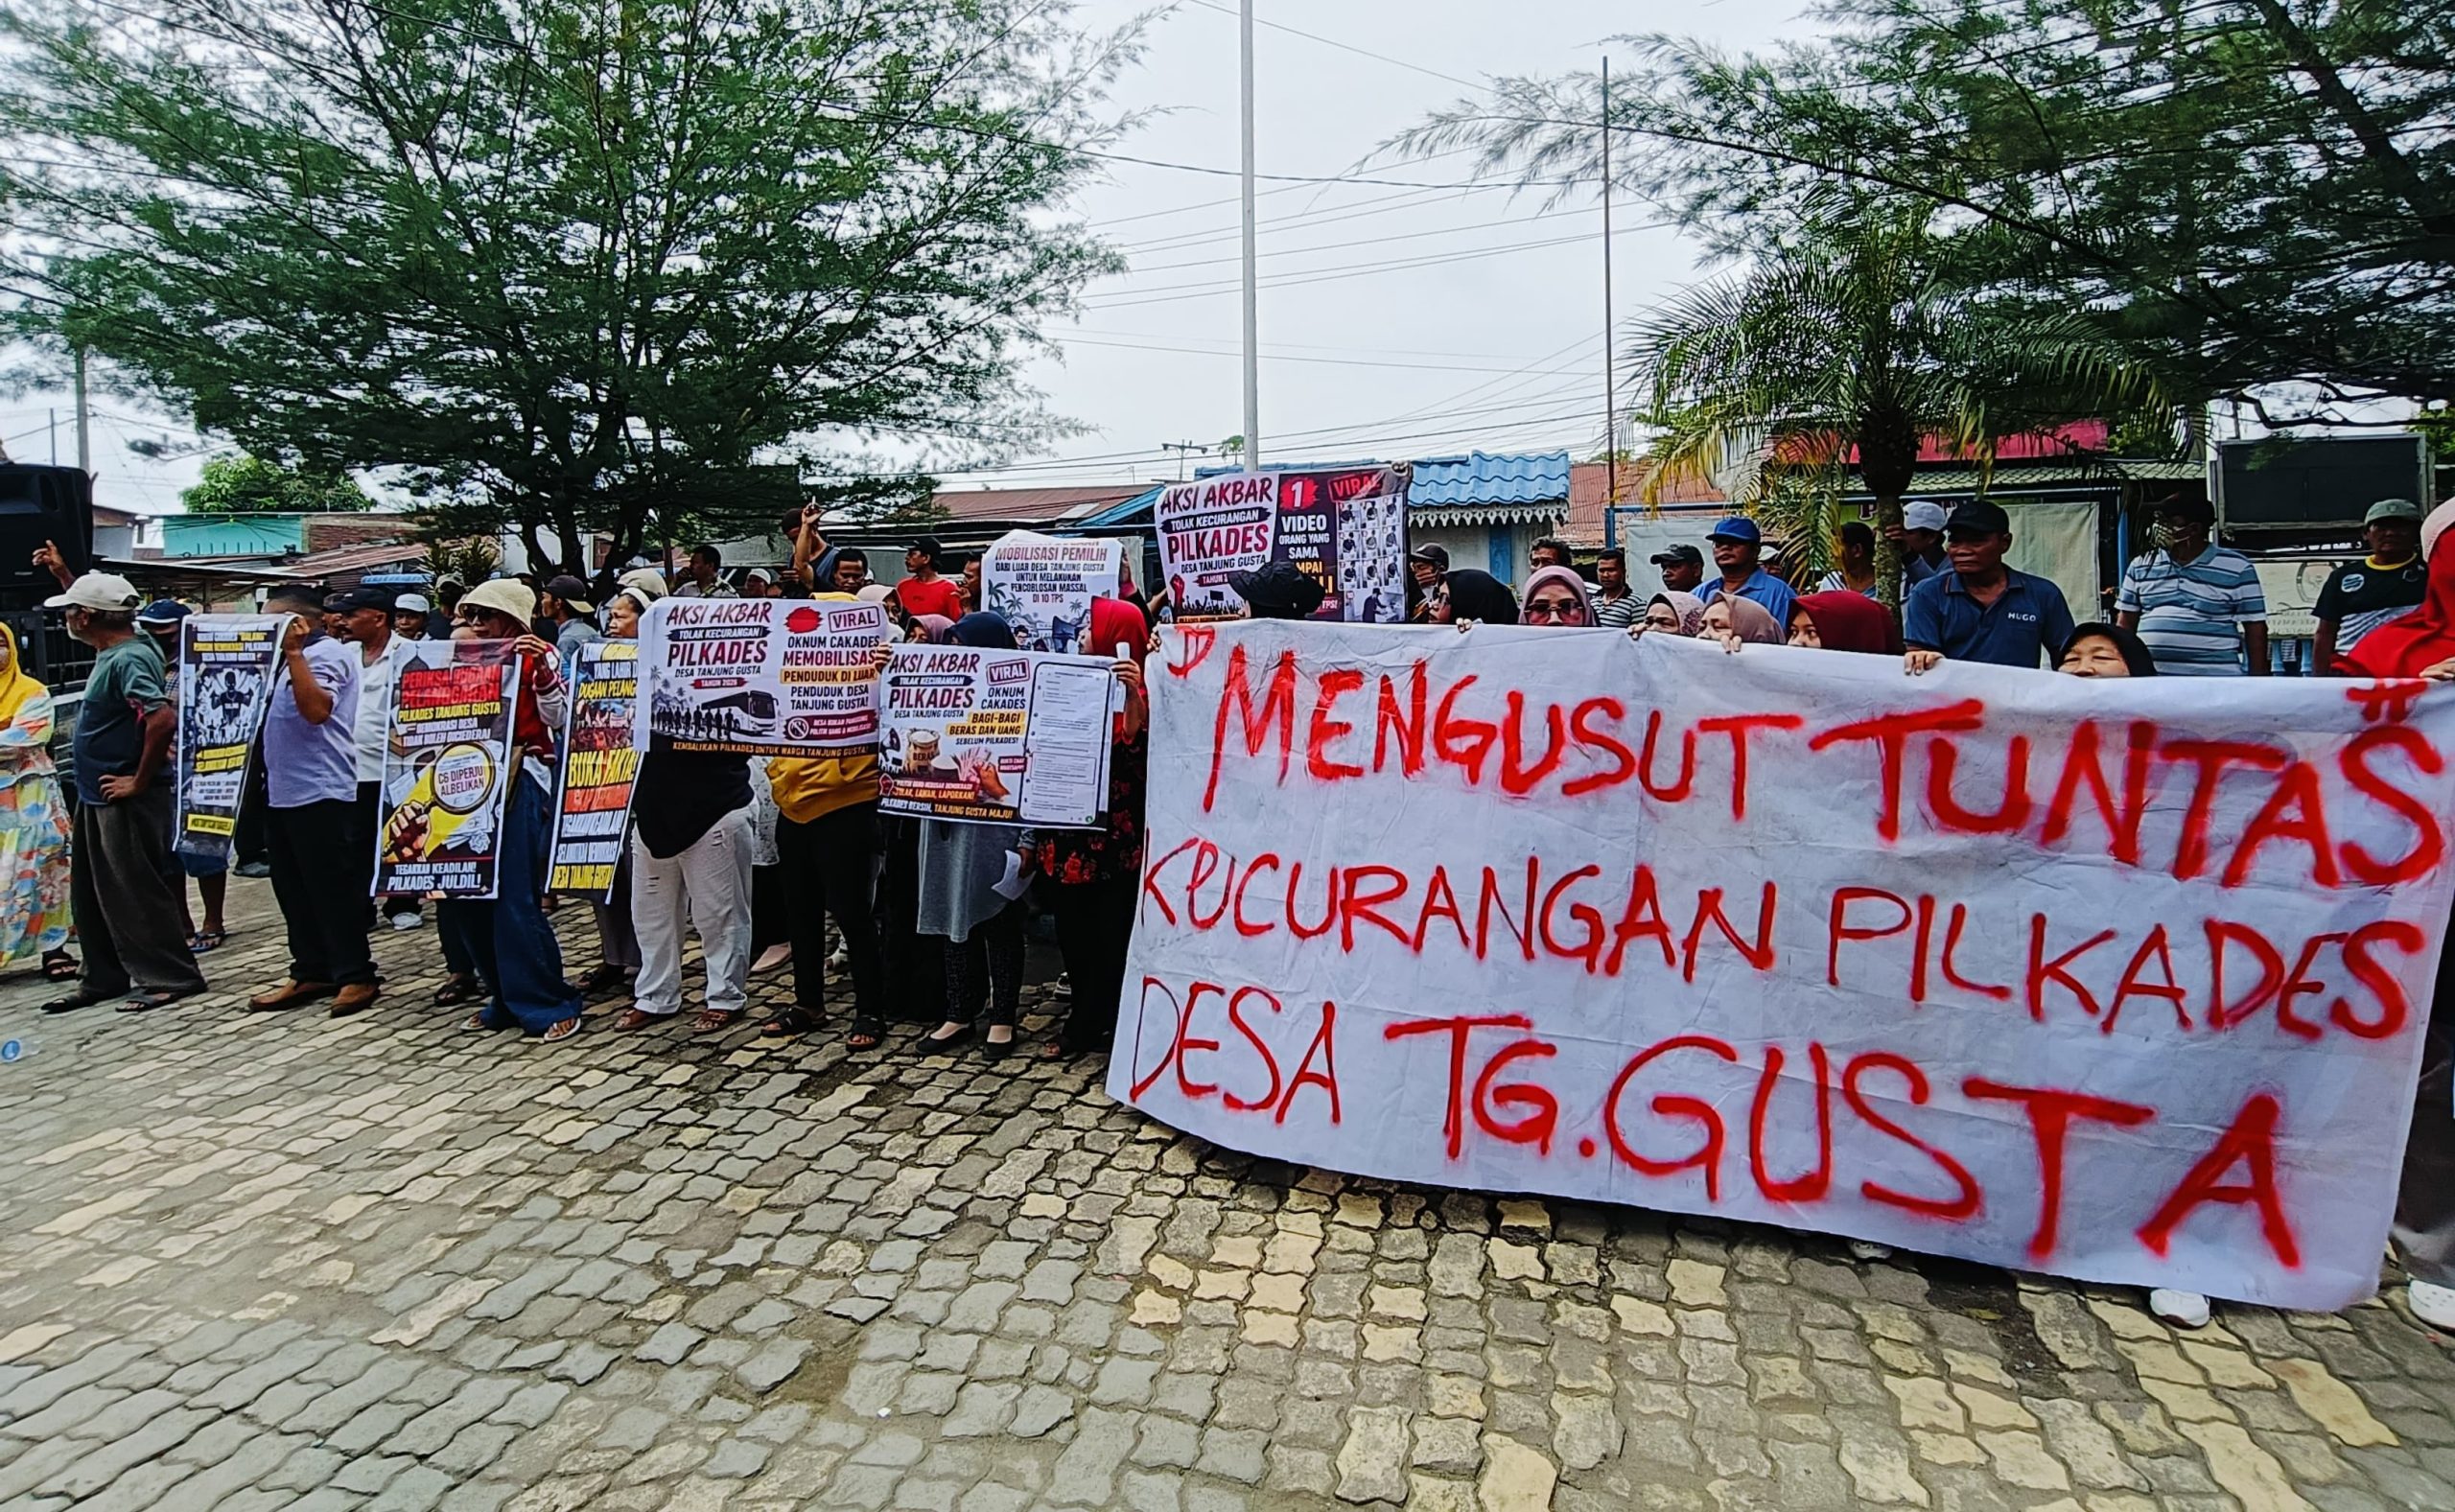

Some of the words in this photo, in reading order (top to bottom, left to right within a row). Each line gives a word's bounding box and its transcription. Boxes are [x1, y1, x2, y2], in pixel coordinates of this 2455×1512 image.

[1160, 485, 1197, 515] AKSI
[1204, 477, 1274, 508] AKBAR
[1291, 481, 1303, 507] 1
[1171, 518, 1195, 531] TOLAK
[1197, 509, 1259, 528] KECURANGAN
[1281, 515, 1327, 533] VIDEO
[1167, 524, 1269, 564] PILKADES
[1278, 534, 1307, 546] ORANG
[1308, 533, 1330, 544] YANG
[995, 547, 1058, 562] MOBILISASI
[1062, 547, 1108, 562] PEMILIH
[1288, 547, 1319, 559] SAMA
[995, 563, 1011, 572] DARI
[1012, 563, 1029, 572] LUAR
[1031, 563, 1048, 572] DESA
[1050, 563, 1081, 572] TANJUNG
[1082, 563, 1105, 572] GUSTA
[1181, 561, 1198, 574] DESA
[1199, 558, 1235, 571] TANJUNG
[1237, 554, 1267, 567] GUSTA
[1296, 561, 1322, 574] MPAI
[1016, 572, 1038, 582] UNTUK
[1039, 572, 1082, 582] MELAKUKAN
[1011, 583, 1057, 593] PENCOBLOSAN
[1059, 583, 1087, 593] MASSAL
[1032, 593, 1040, 603] DI
[1041, 593, 1049, 603] 10
[1051, 593, 1064, 603] TPS
[666, 604, 709, 626] AKSI
[710, 601, 772, 624] AKBAR
[832, 611, 876, 629] VIRAL
[2007, 612, 2037, 622] HUGO
[679, 630, 704, 640] TOLAK
[787, 636, 827, 648] OKNUM
[830, 635, 880, 648] CAKADES
[667, 640, 768, 667] PILKADES
[783, 649, 877, 666] MEMOBILISAS
[675, 668, 694, 678] DESA
[697, 667, 734, 677] TANJUNG
[736, 665, 761, 675] GUSTA
[888, 654, 924, 674] AKSI
[925, 653, 981, 673] AKBAR
[402, 669, 450, 689] PERIKSA
[783, 670, 838, 682] PENDUDUK
[841, 670, 851, 682] DI
[853, 668, 876, 682] LUAR
[991, 663, 1026, 681] VIRAL
[577, 681, 608, 700] DUGAAN
[608, 679, 637, 698] PELANG
[790, 686, 844, 697] PENDUDUK
[847, 684, 869, 697] DESA
[988, 686, 1025, 698] OKNUM
[790, 699, 834, 710] TANJUNG
[837, 696, 869, 710] GUSTA!
[888, 687, 975, 709] PILKADES
[981, 699, 1026, 710] CAKADES
[398, 708, 434, 723] PILKADES
[434, 704, 471, 719] TANJUNG
[471, 701, 502, 716] GUSTA
[894, 710, 910, 719] DESA
[912, 709, 941, 718] TANJUNG
[943, 709, 965, 718] GUSTA
[971, 712, 1020, 723] BAGI-BAGI
[949, 725, 976, 735] BERAS
[978, 725, 995, 735] DAN
[997, 725, 1021, 735] UANG
[955, 737, 984, 746] SEBELUM
[985, 736, 1019, 745] PILKADES!
[672, 742, 718, 752] KEMBALIKAN
[720, 744, 754, 754] PILKADES
[755, 746, 779, 755] UNTUK
[782, 747, 806, 756] WARGA
[807, 747, 841, 757] TANJUNG
[450, 765, 483, 781] DIPERJU
[568, 750, 604, 787] BUKA
[1202, 641, 1805, 822] MENGUSUT
[1809, 696, 2446, 890] TUNTAS
[441, 778, 484, 797] ALBELIKAN
[934, 803, 965, 815] TANJUNG
[965, 807, 987, 818] GUSTA
[988, 808, 1014, 820] MAJU!
[432, 861, 478, 874] KEADILAN!
[386, 875, 435, 891] PILKADES
[436, 873, 481, 889] JULDIL!
[1827, 884, 2426, 1041] PILKADES
[1129, 974, 1341, 1126] DESA
